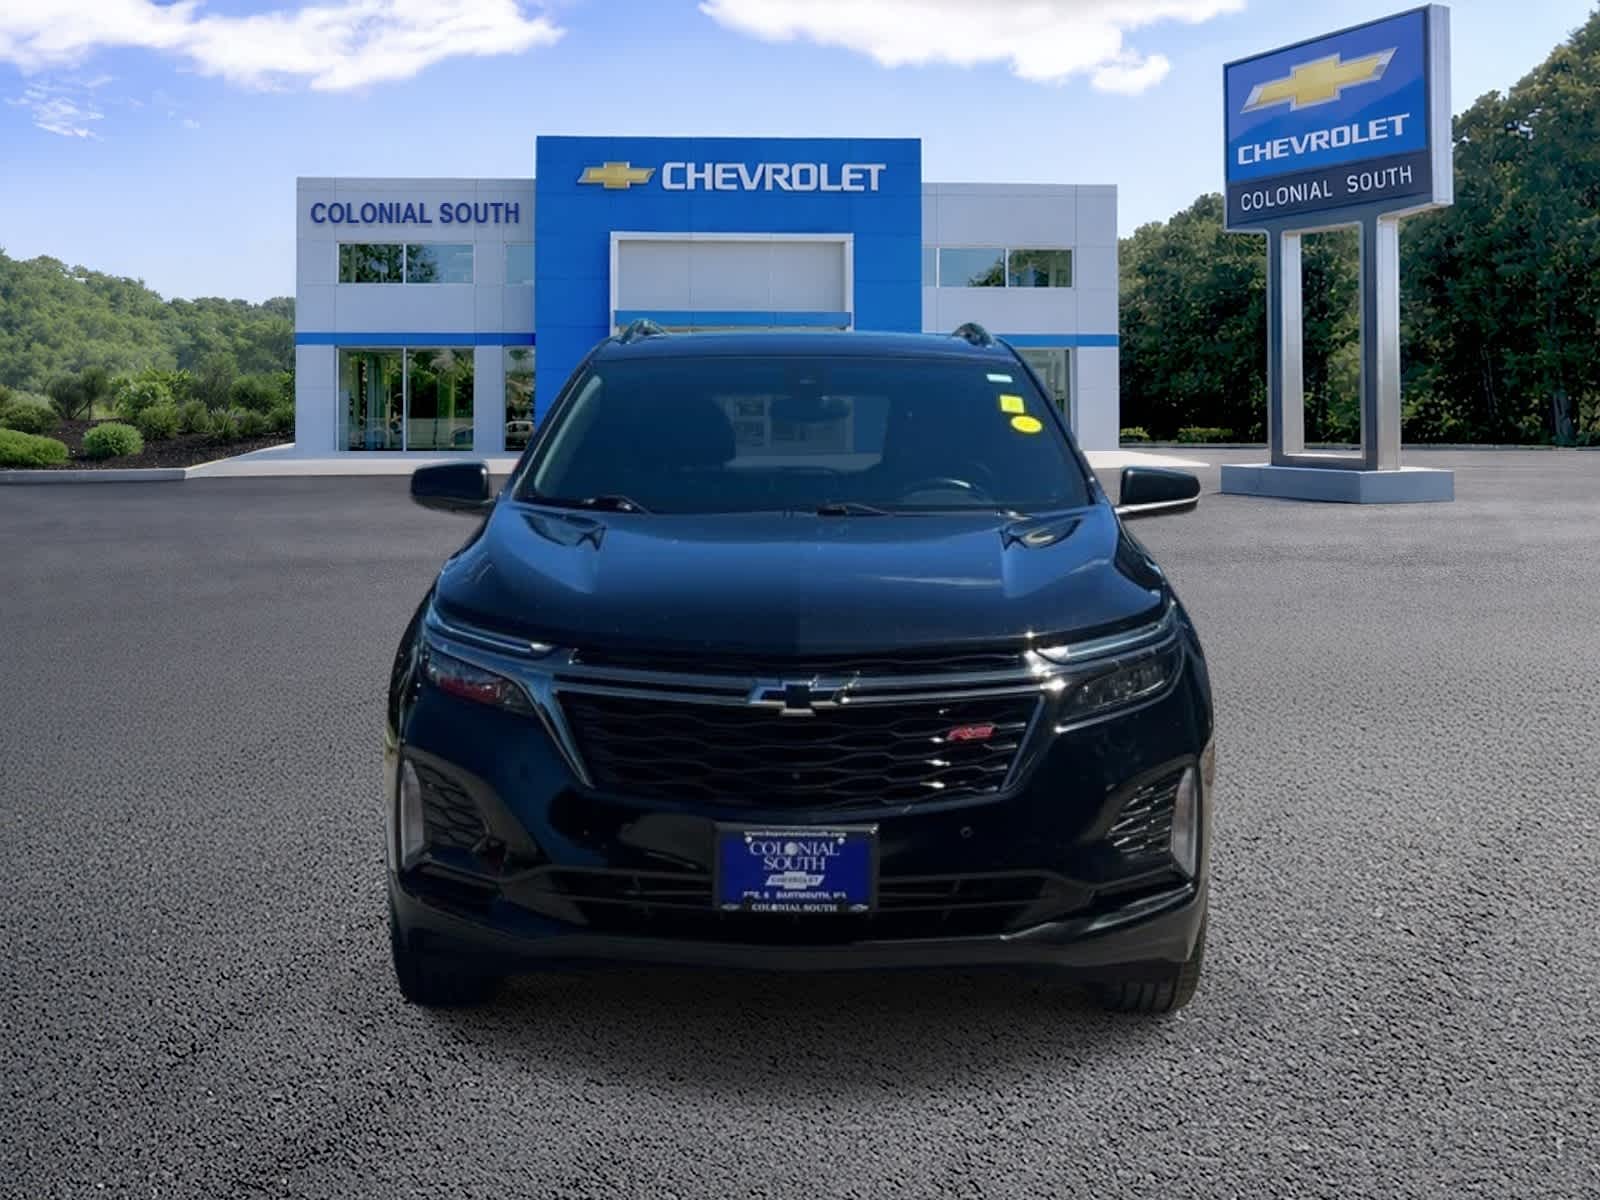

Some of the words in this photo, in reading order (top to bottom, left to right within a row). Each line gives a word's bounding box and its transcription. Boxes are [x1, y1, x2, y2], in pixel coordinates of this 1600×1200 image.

[1238, 113, 1410, 165] CHEVROLET
[662, 161, 887, 192] CHEVROLET
[1241, 180, 1333, 211] COLONIAL
[1346, 165, 1413, 193] SOUTH
[310, 202, 432, 224] COLONIAL
[439, 202, 520, 224] SOUTH
[749, 841, 841, 856] COLONIAL
[763, 856, 826, 871] SOUTH
[751, 904, 802, 912] COLONIAL
[803, 904, 838, 912] SOUTH
